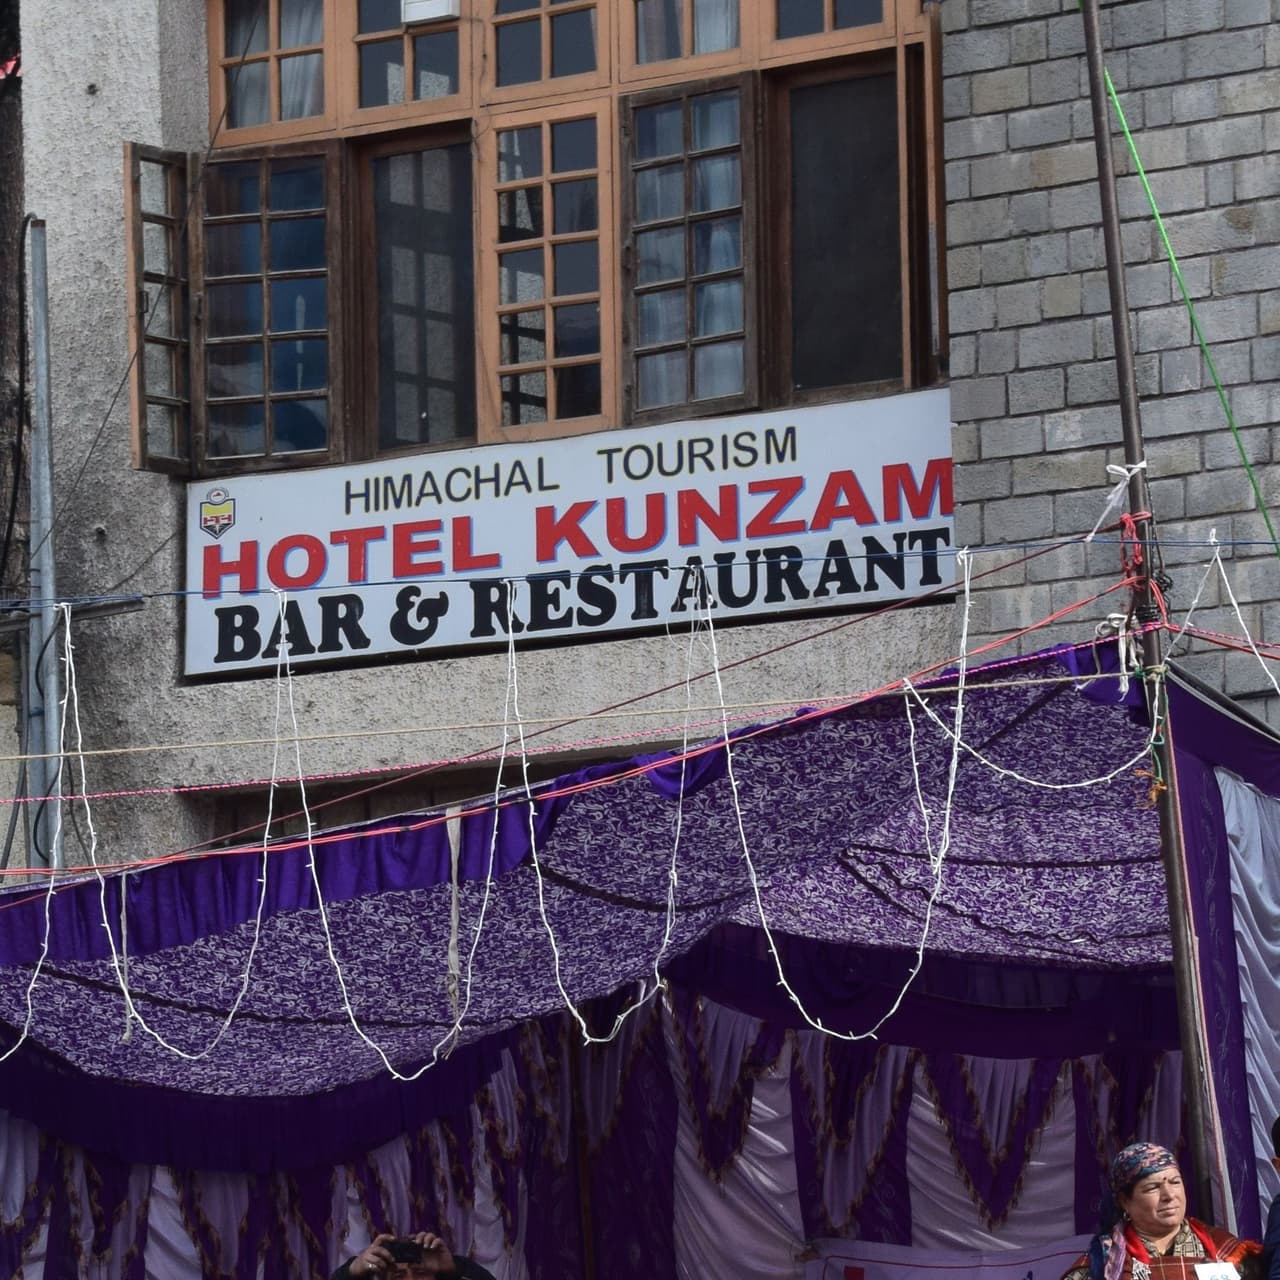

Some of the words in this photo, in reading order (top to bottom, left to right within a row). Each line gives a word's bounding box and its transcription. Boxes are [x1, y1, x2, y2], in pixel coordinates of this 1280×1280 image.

[201, 515, 500, 600] HOTEL
[535, 458, 955, 563] KUNZAM
[345, 458, 559, 514] HIMACHAL
[597, 426, 798, 482] TOURISM
[214, 593, 371, 664] BAR
[389, 586, 449, 645] &
[470, 527, 951, 639] RESTAURANT
